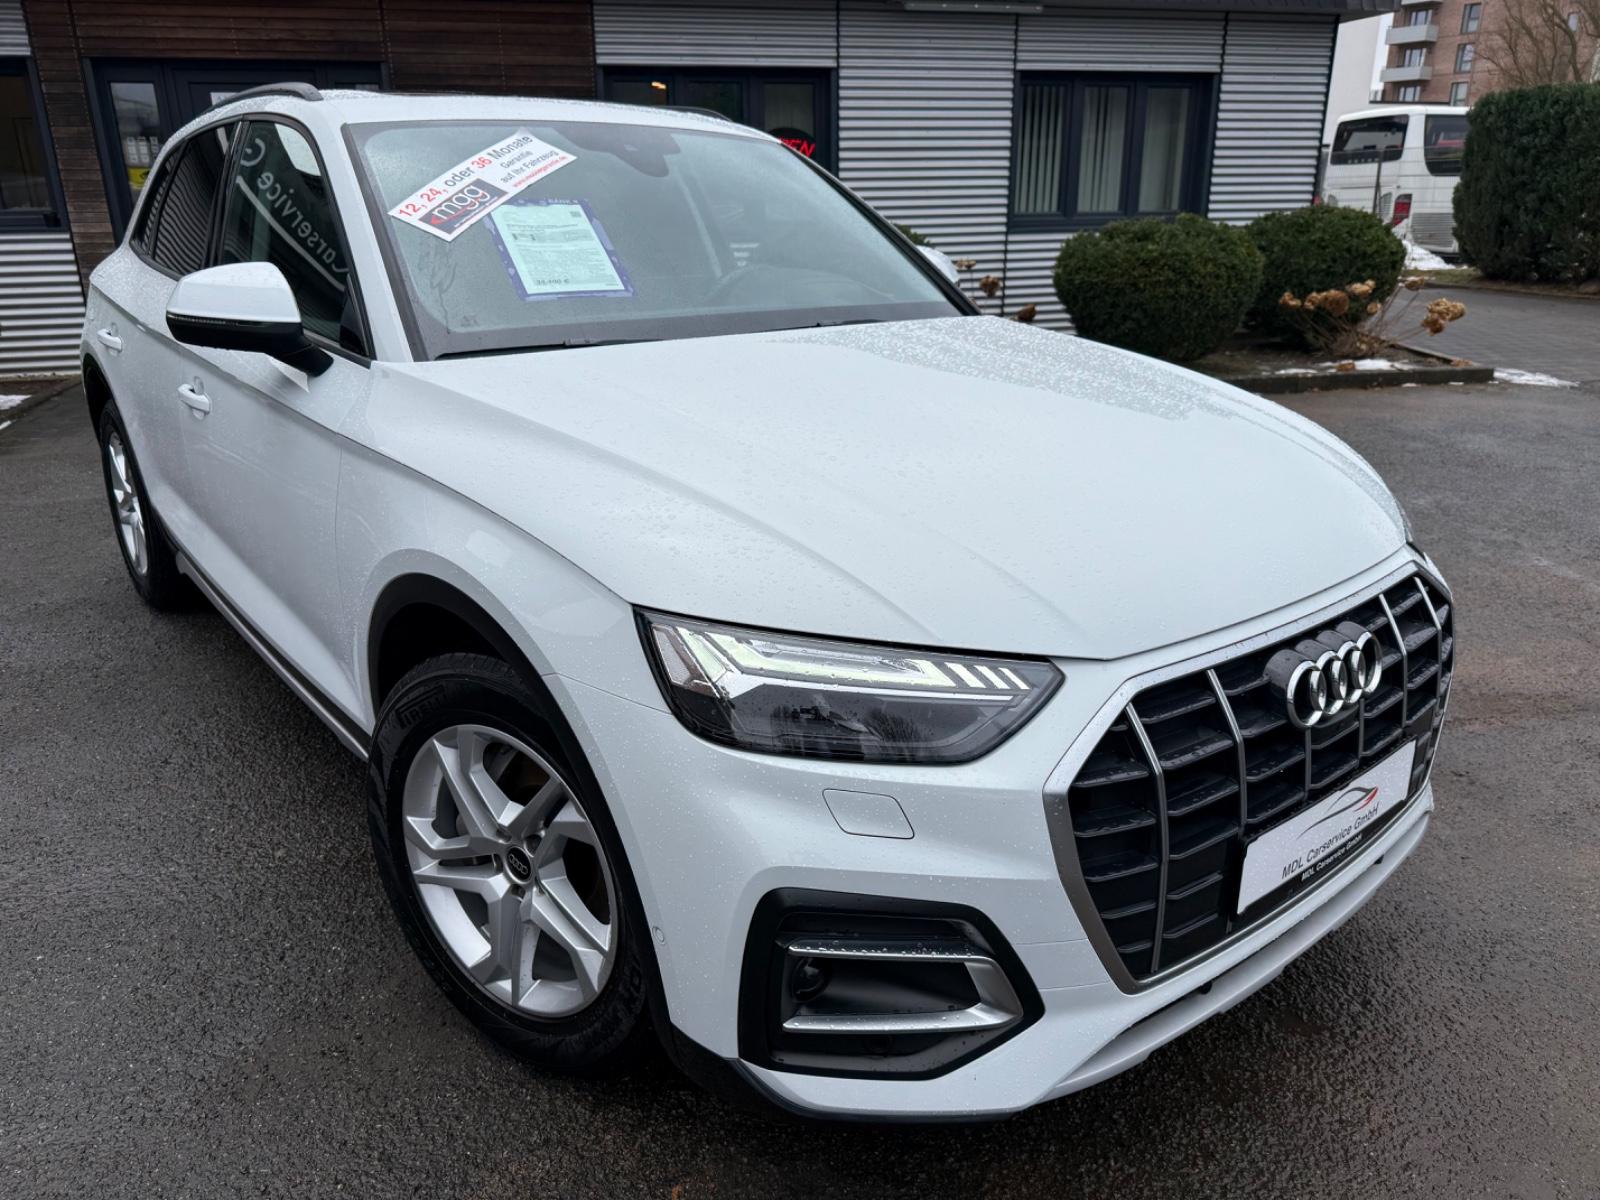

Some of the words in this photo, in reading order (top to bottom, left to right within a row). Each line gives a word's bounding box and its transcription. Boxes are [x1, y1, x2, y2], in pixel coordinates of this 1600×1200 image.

[399, 203, 427, 217] 12,
[420, 187, 448, 202] 24,
[444, 167, 475, 187] oder
[471, 156, 492, 169] 36
[487, 136, 533, 159] Monate
[432, 185, 491, 219] mgg
[1282, 857, 1304, 879] MDL
[1306, 825, 1352, 862] Carservice
[1354, 801, 1380, 830] GmbH
[1301, 866, 1315, 881] MDL
[1316, 847, 1346, 870] Carservice
